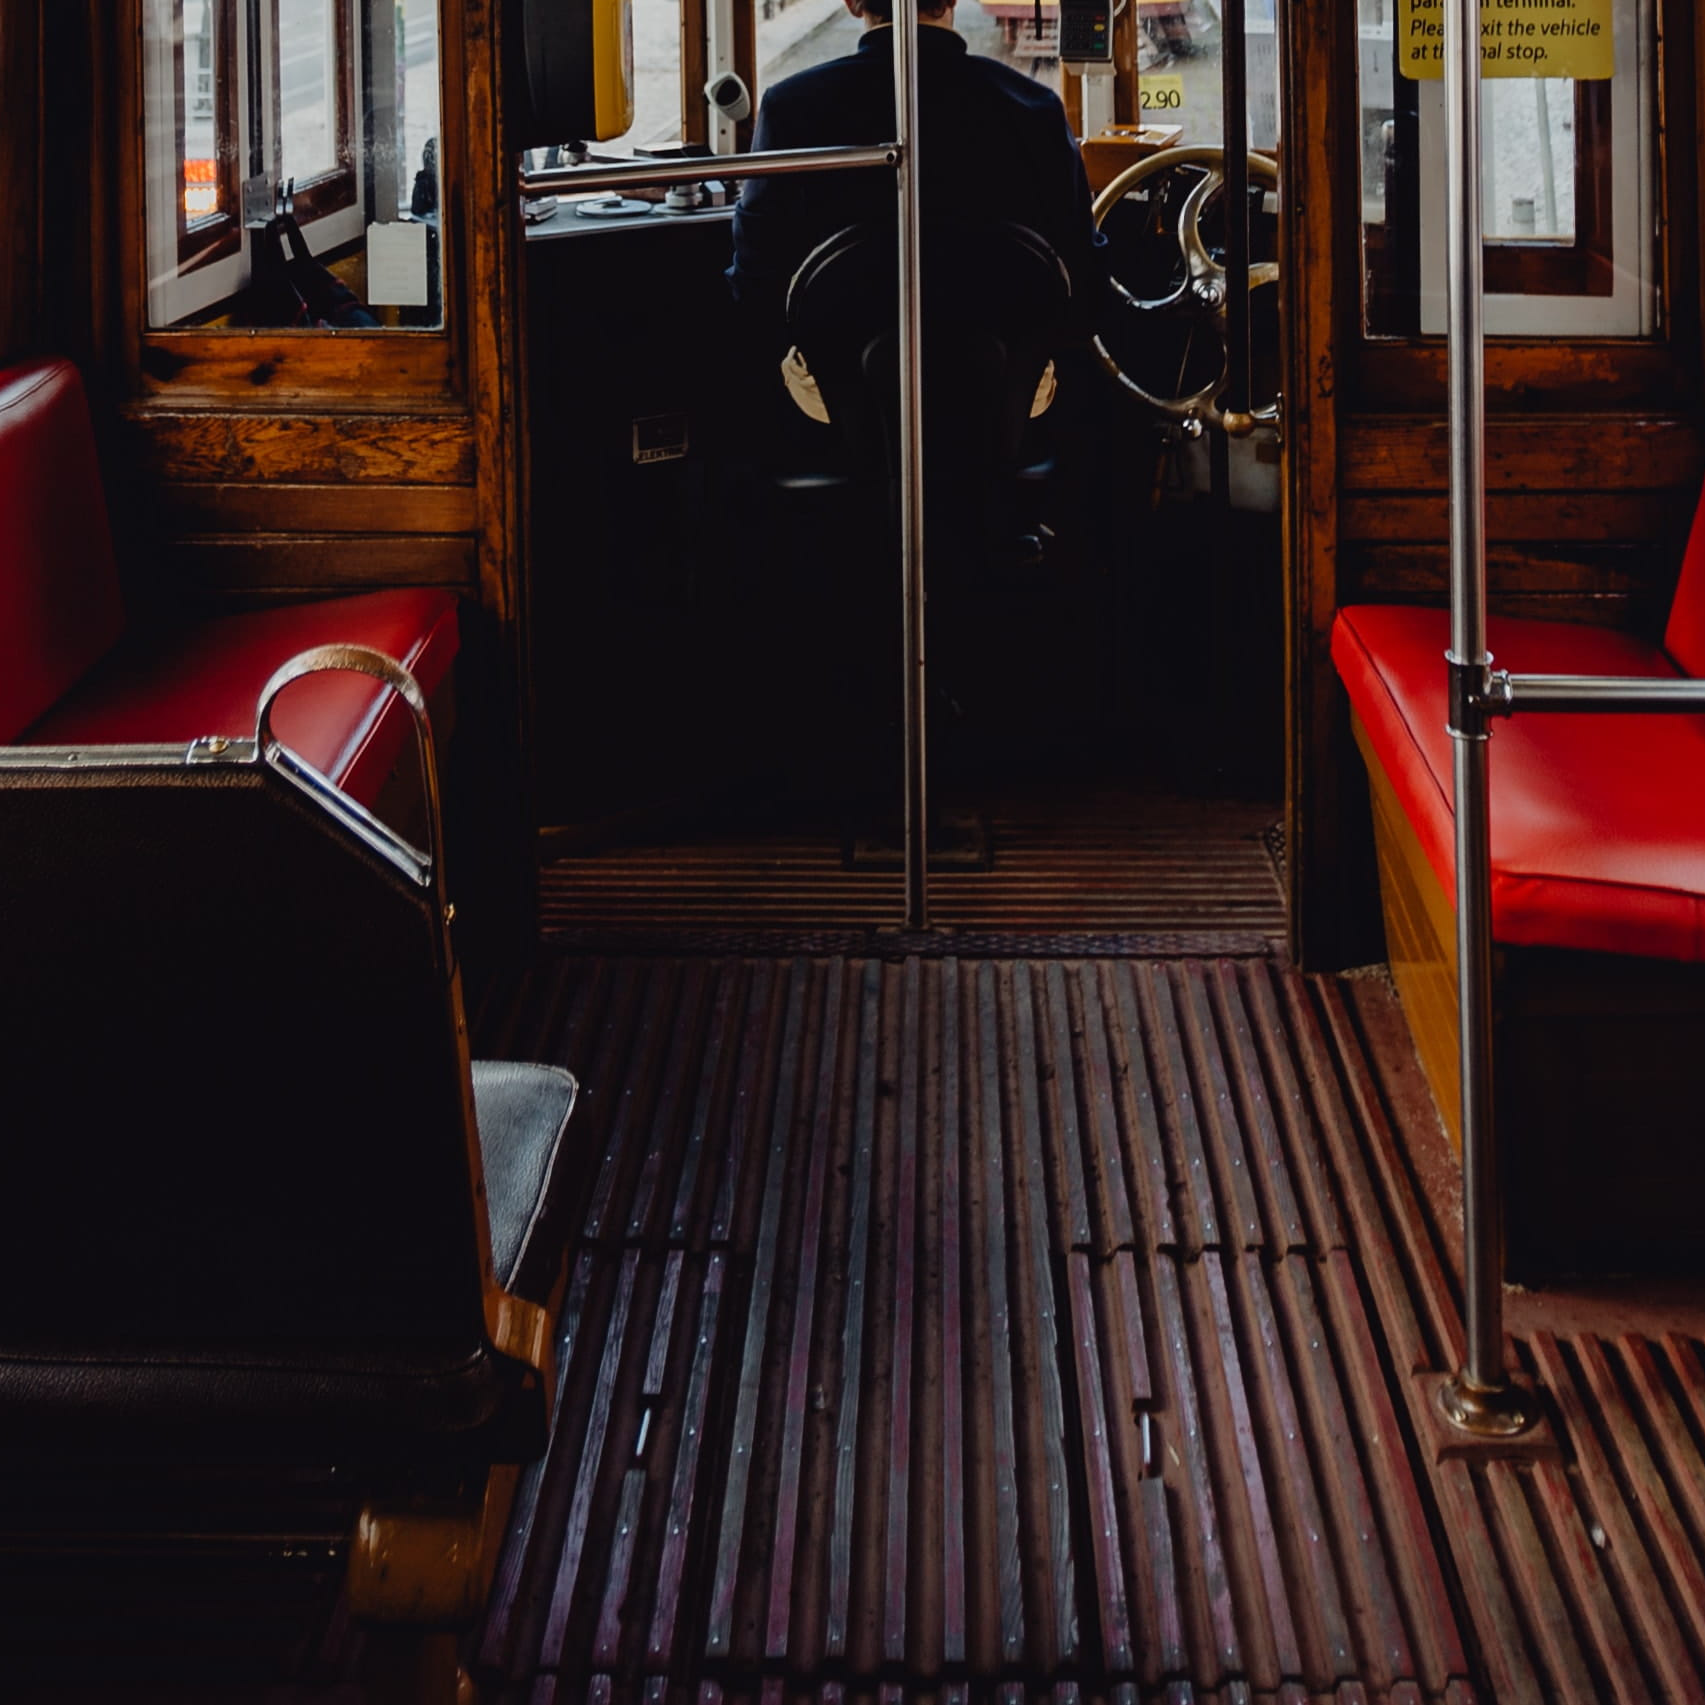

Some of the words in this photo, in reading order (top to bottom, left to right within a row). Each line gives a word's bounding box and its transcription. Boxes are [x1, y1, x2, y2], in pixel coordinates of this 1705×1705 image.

[1480, 19, 1502, 36] xit
[1508, 19, 1535, 36] the
[1540, 17, 1601, 36] vehicle
[1411, 44, 1428, 59] at
[1506, 44, 1548, 64] stop.
[1140, 89, 1181, 110] 2.90
